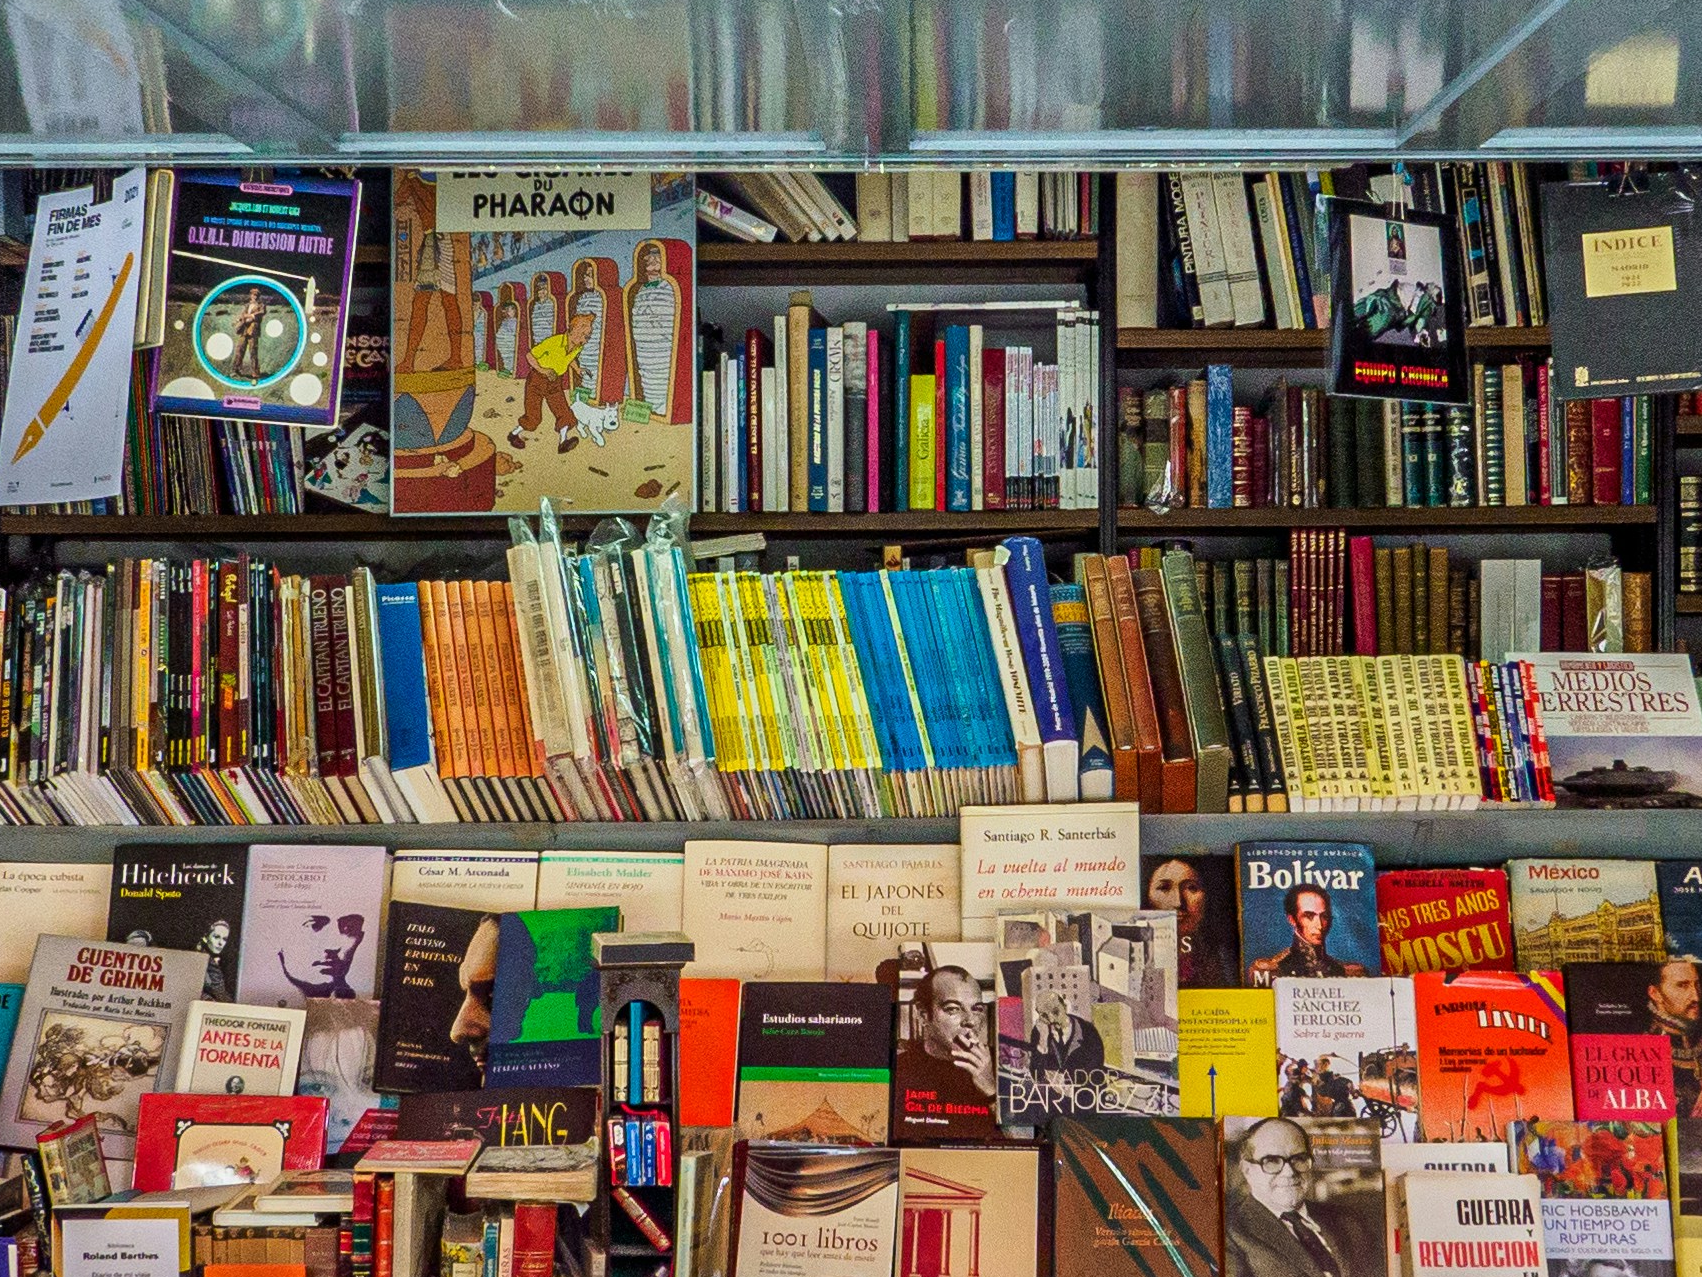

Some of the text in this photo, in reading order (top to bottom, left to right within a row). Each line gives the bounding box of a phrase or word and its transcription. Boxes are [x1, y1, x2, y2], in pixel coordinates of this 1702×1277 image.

[534, 178, 552, 192] DU
[49, 204, 88, 222] FIRMAS
[1552, 672, 1652, 692] MEDIOS
[983, 828, 1116, 845] Santiago R. Santerbás
[2, 870, 84, 884] La época cubista
[120, 863, 235, 886] Hitchcock
[1247, 861, 1364, 892] Bolívar
[1528, 864, 1600, 881] México
[841, 883, 944, 902] EL JAPONÉS
[977, 883, 1123, 899] en ochenta mundos
[881, 906, 904, 916] DEL
[852, 921, 931, 940] QUIJOTE
[76, 947, 164, 972] CUENTOS
[66, 965, 166, 992] DE GRIMM
[1292, 987, 1346, 1000] RAFAEL
[1292, 999, 1361, 1014] SÁNCHEZ
[762, 1013, 863, 1025] Estudios saharianos
[1293, 1013, 1362, 1026] FERLOSIO
[201, 1031, 284, 1051] ANTES DE LA
[199, 1047, 282, 1069] TORMENTA
[1585, 1064, 1664, 1086] DUQUE
[905, 1088, 937, 1101] JAIME
[1456, 1199, 1535, 1226] GUERRA
[83, 1251, 159, 1261] Roland Barthes
[1418, 1241, 1540, 1269] REVOLUCION
